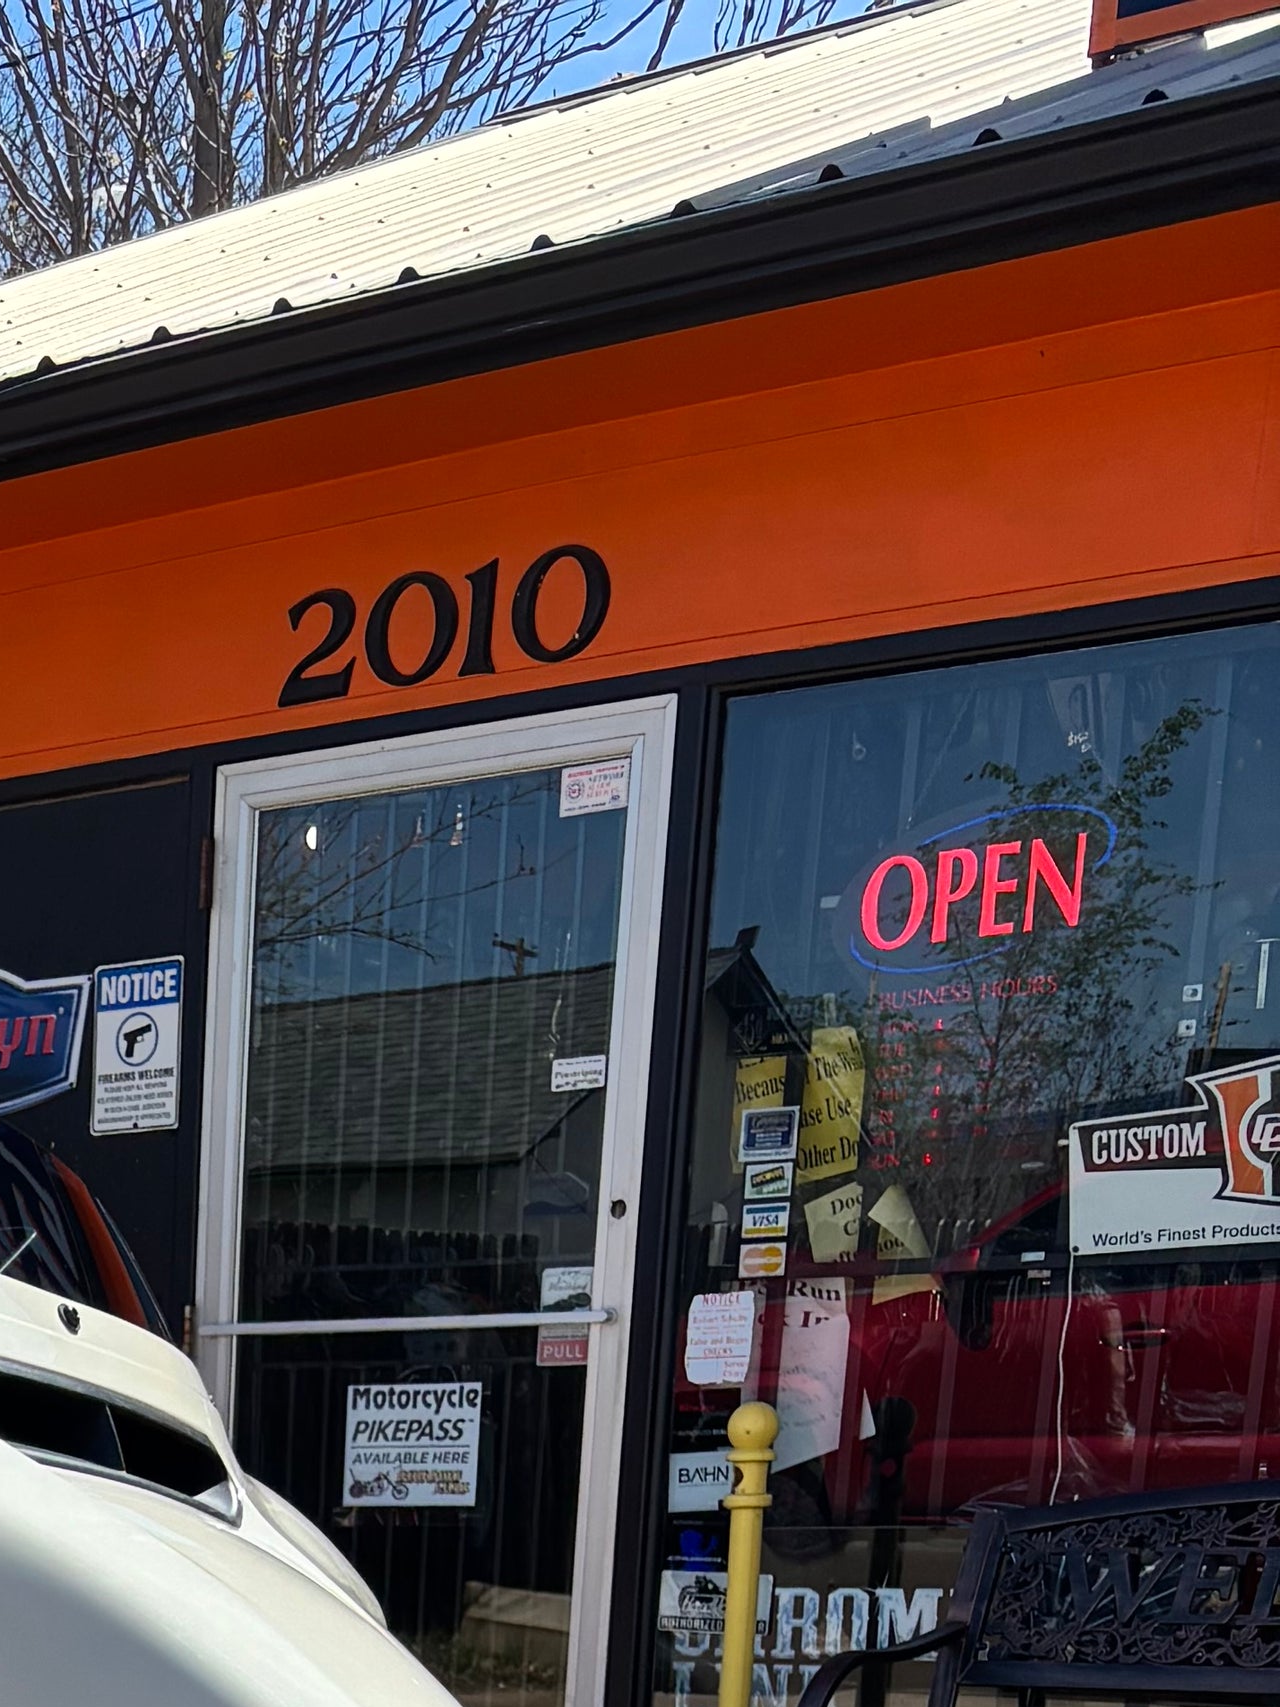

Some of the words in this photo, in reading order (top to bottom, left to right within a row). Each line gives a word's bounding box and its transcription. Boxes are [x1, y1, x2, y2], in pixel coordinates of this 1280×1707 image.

[278, 544, 612, 708] 2010
[860, 832, 1087, 950] OPEN
[101, 968, 177, 1005] NOTICE
[138, 1067, 175, 1080] WELCOME
[825, 1096, 852, 1121] Use
[1091, 1121, 1207, 1165] CUSTOM
[797, 1144, 836, 1171] Other
[753, 1214, 780, 1227] VISA
[1093, 1230, 1152, 1247] World's
[1157, 1227, 1206, 1243] Finest
[543, 1345, 583, 1359] PULL
[352, 1385, 479, 1415] Motorcycle
[352, 1452, 430, 1465] AVAILABLE
[432, 1451, 470, 1464] HERE
